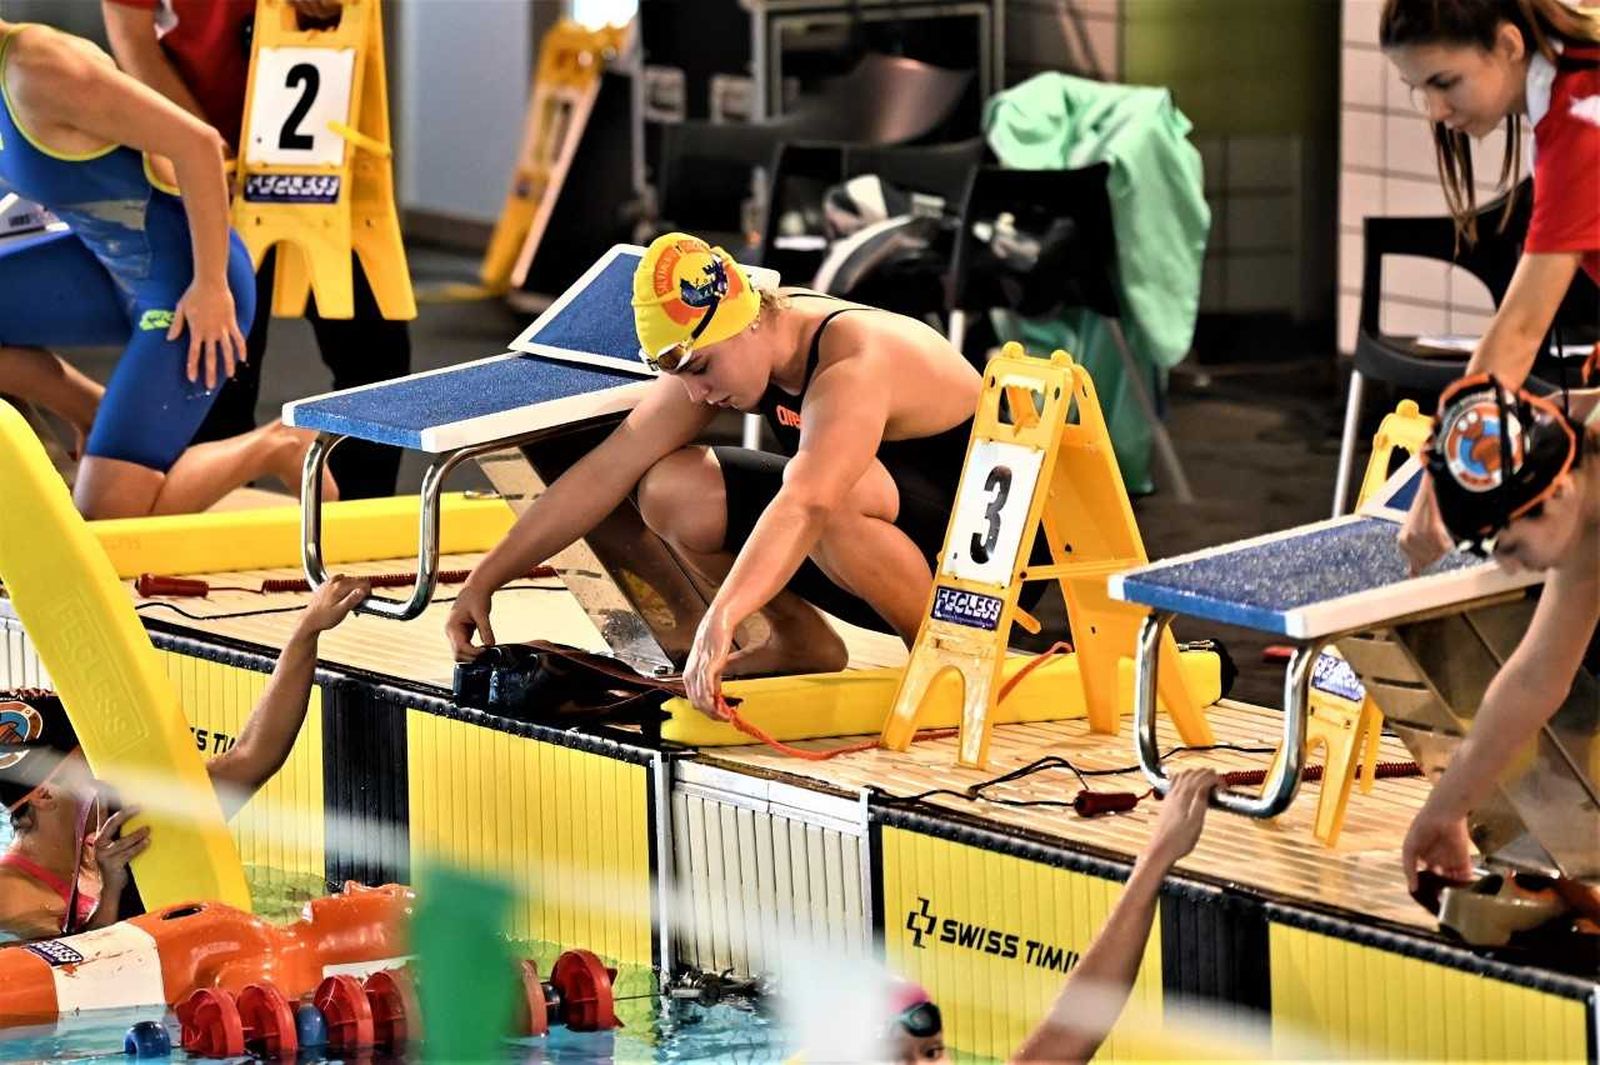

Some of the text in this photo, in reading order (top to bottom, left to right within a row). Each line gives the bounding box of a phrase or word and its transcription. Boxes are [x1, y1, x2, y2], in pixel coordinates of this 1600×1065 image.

[278, 63, 320, 150] 2
[969, 465, 1012, 564] 3
[940, 919, 1020, 959] SWISS
